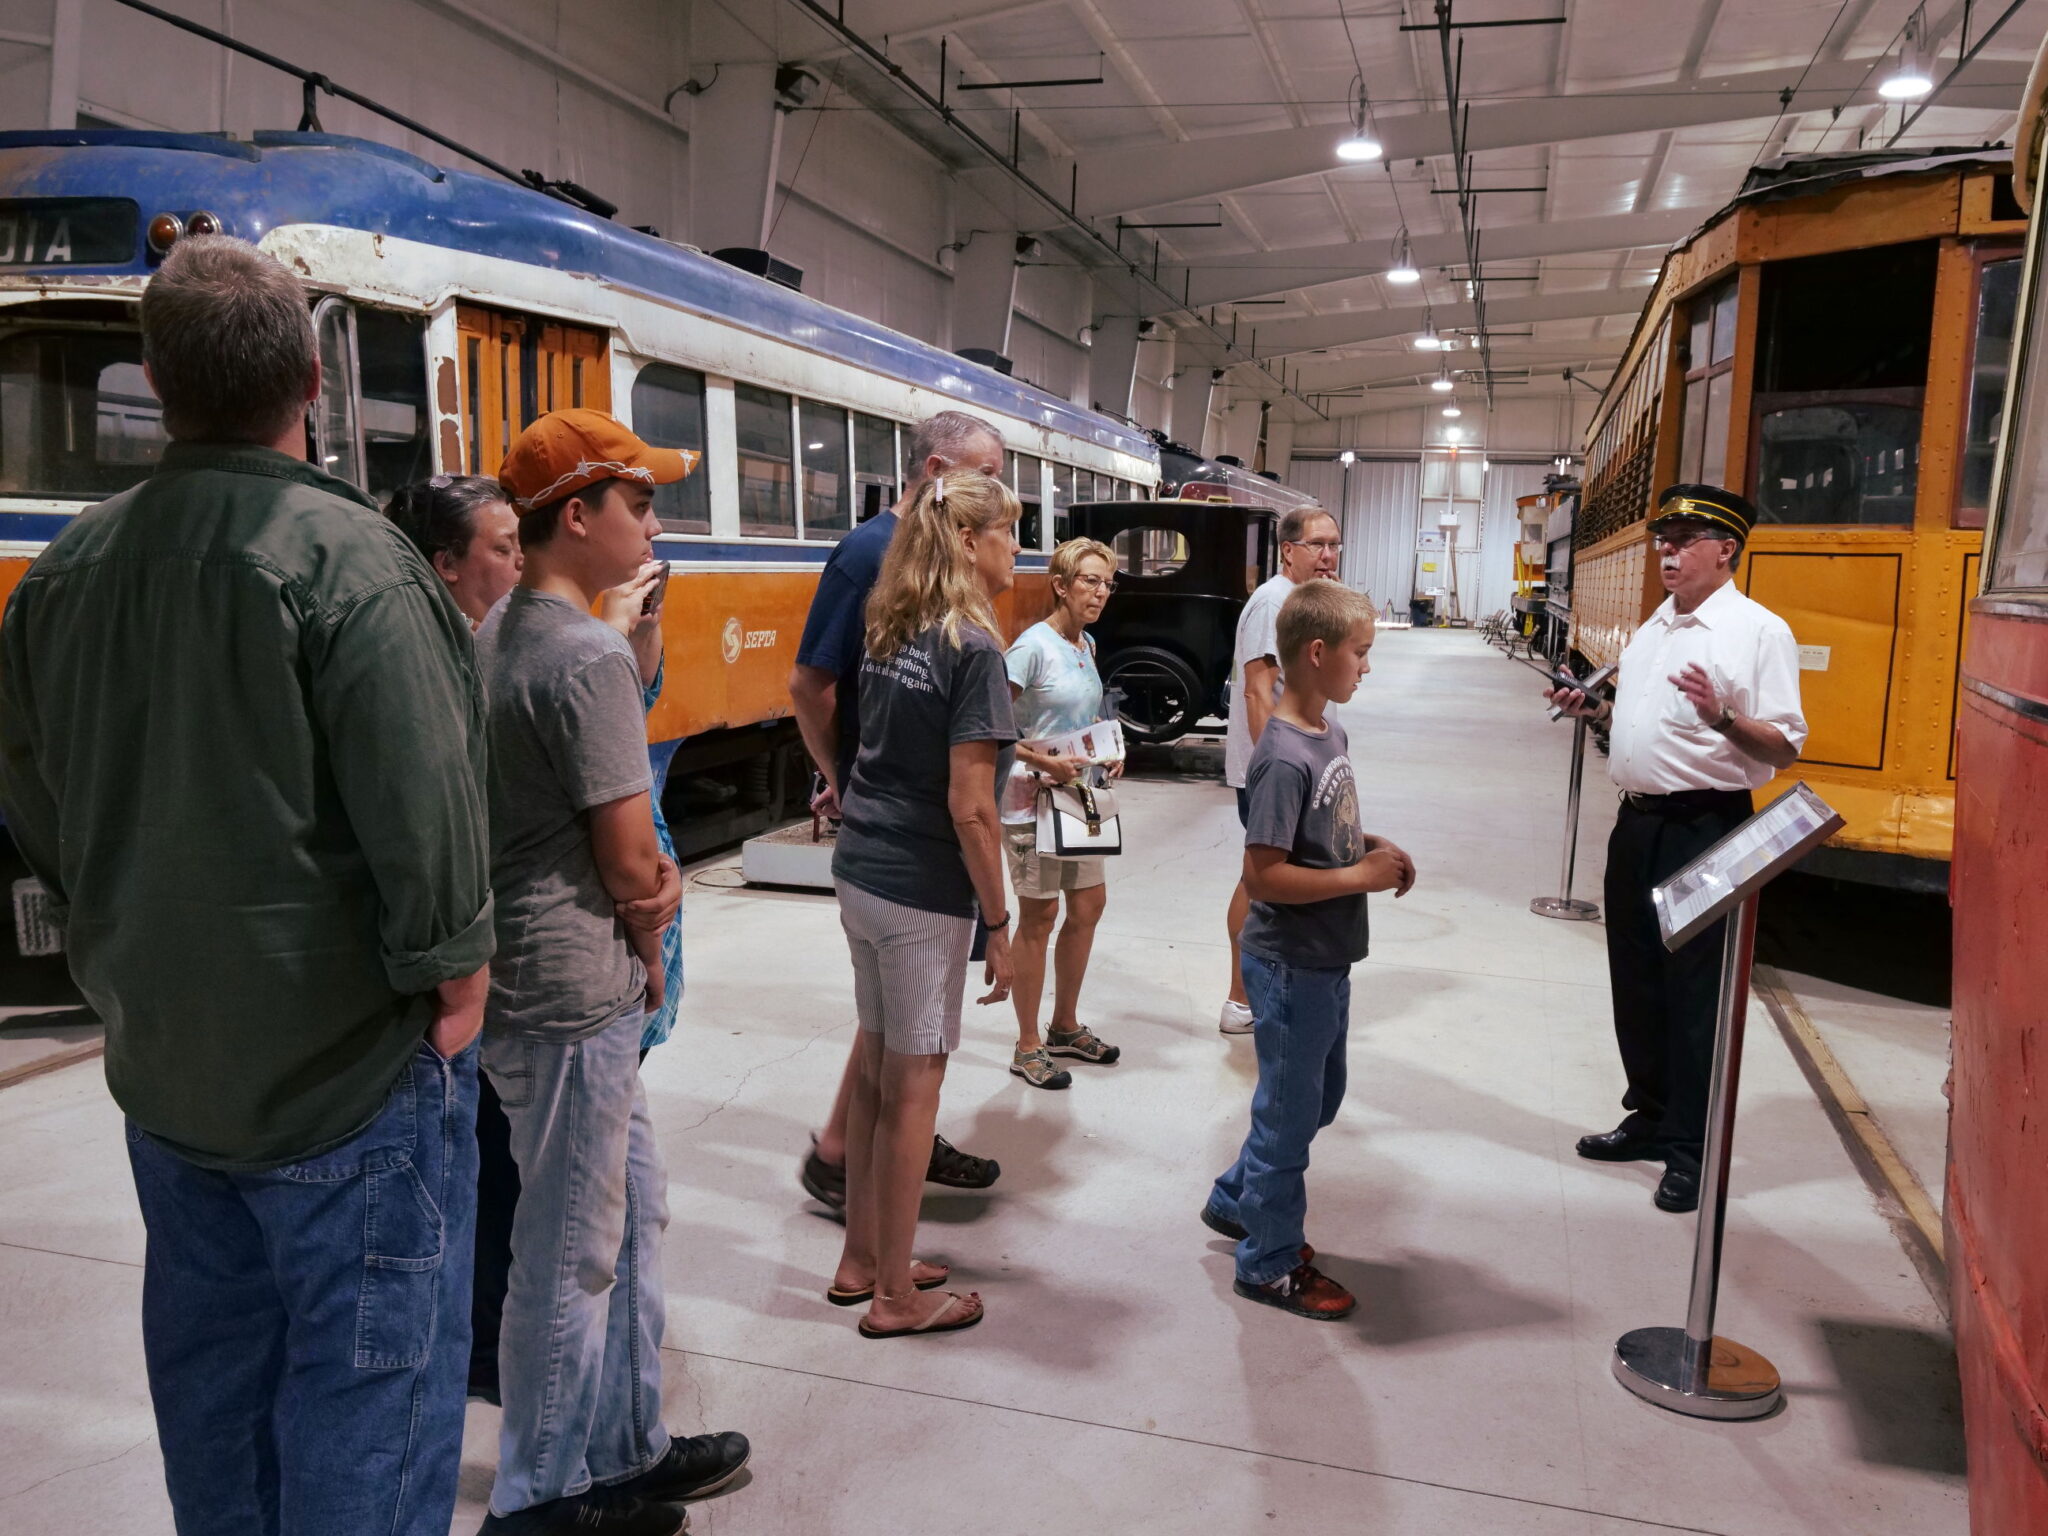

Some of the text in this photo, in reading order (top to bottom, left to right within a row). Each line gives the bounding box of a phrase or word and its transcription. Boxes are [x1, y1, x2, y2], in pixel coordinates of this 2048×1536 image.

[744, 630, 777, 649] SEPTA
[908, 645, 932, 667] back,
[1322, 768, 1346, 807] STATE
